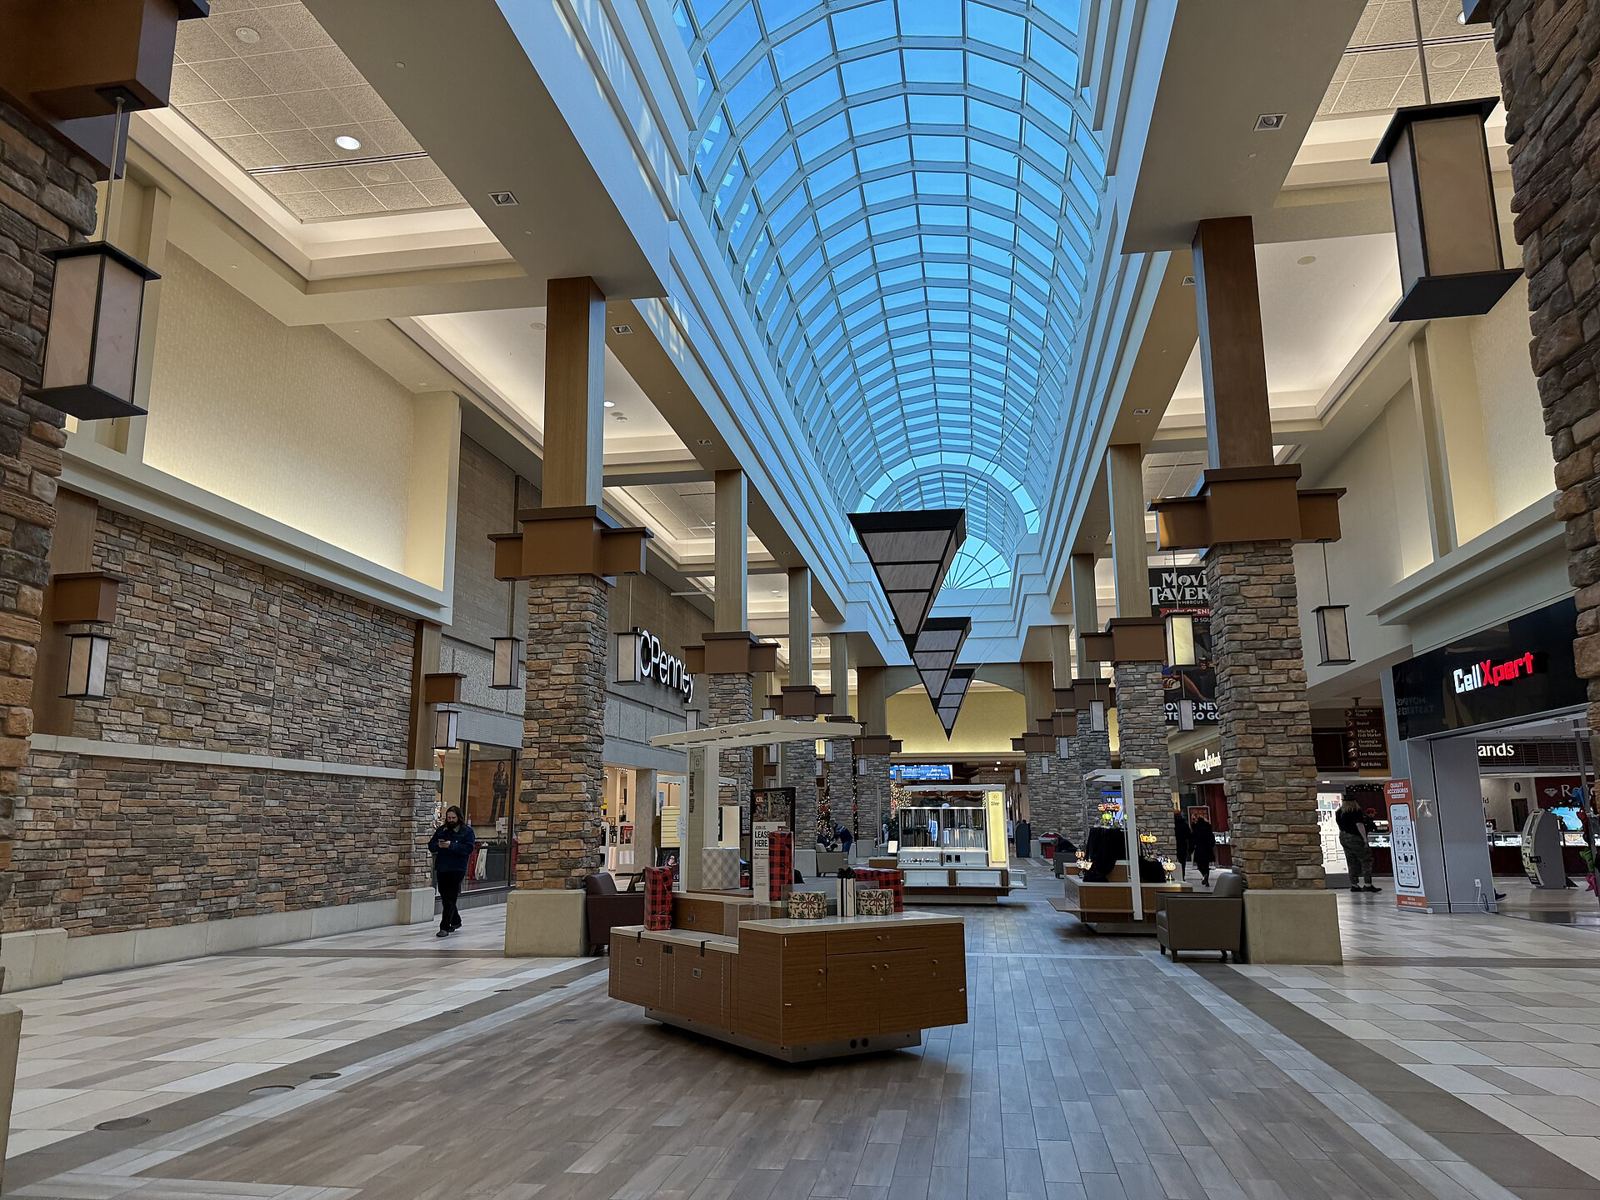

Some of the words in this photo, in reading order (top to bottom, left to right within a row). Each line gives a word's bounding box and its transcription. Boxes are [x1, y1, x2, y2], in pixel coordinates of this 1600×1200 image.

[1161, 570, 1208, 588] MOVI
[1149, 586, 1209, 605] TAVER
[637, 627, 695, 704] CPenney
[1453, 652, 1534, 694] CellXpert
[1478, 742, 1515, 757] ands
